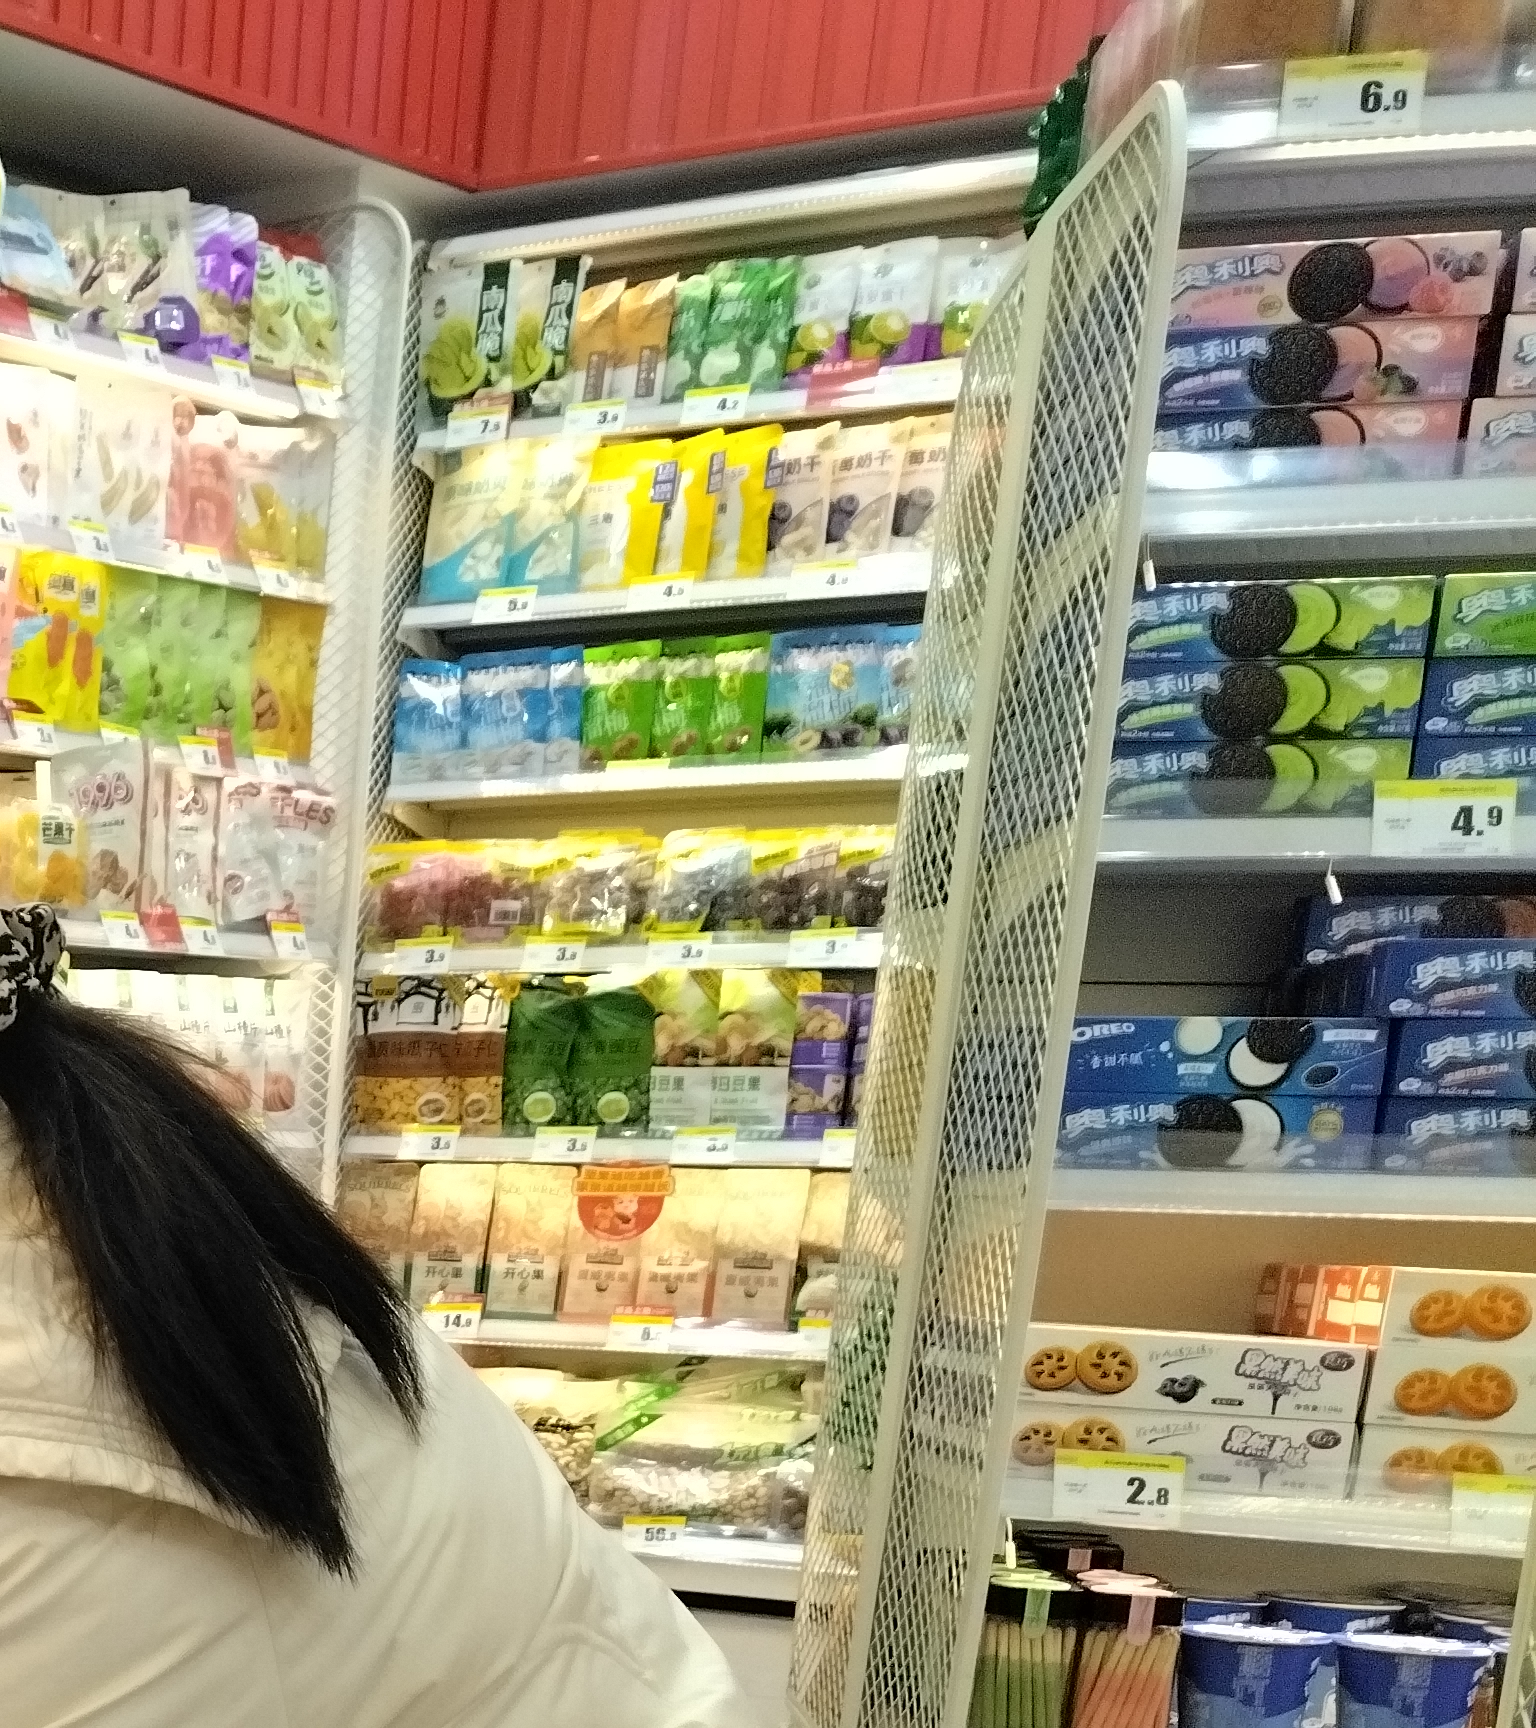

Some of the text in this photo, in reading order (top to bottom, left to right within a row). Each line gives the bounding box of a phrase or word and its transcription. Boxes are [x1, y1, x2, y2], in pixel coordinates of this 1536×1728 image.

[1360, 79, 1407, 112] 6.9
[1451, 804, 1503, 837] 4.9
[1126, 1475, 1170, 1507] 2.8
